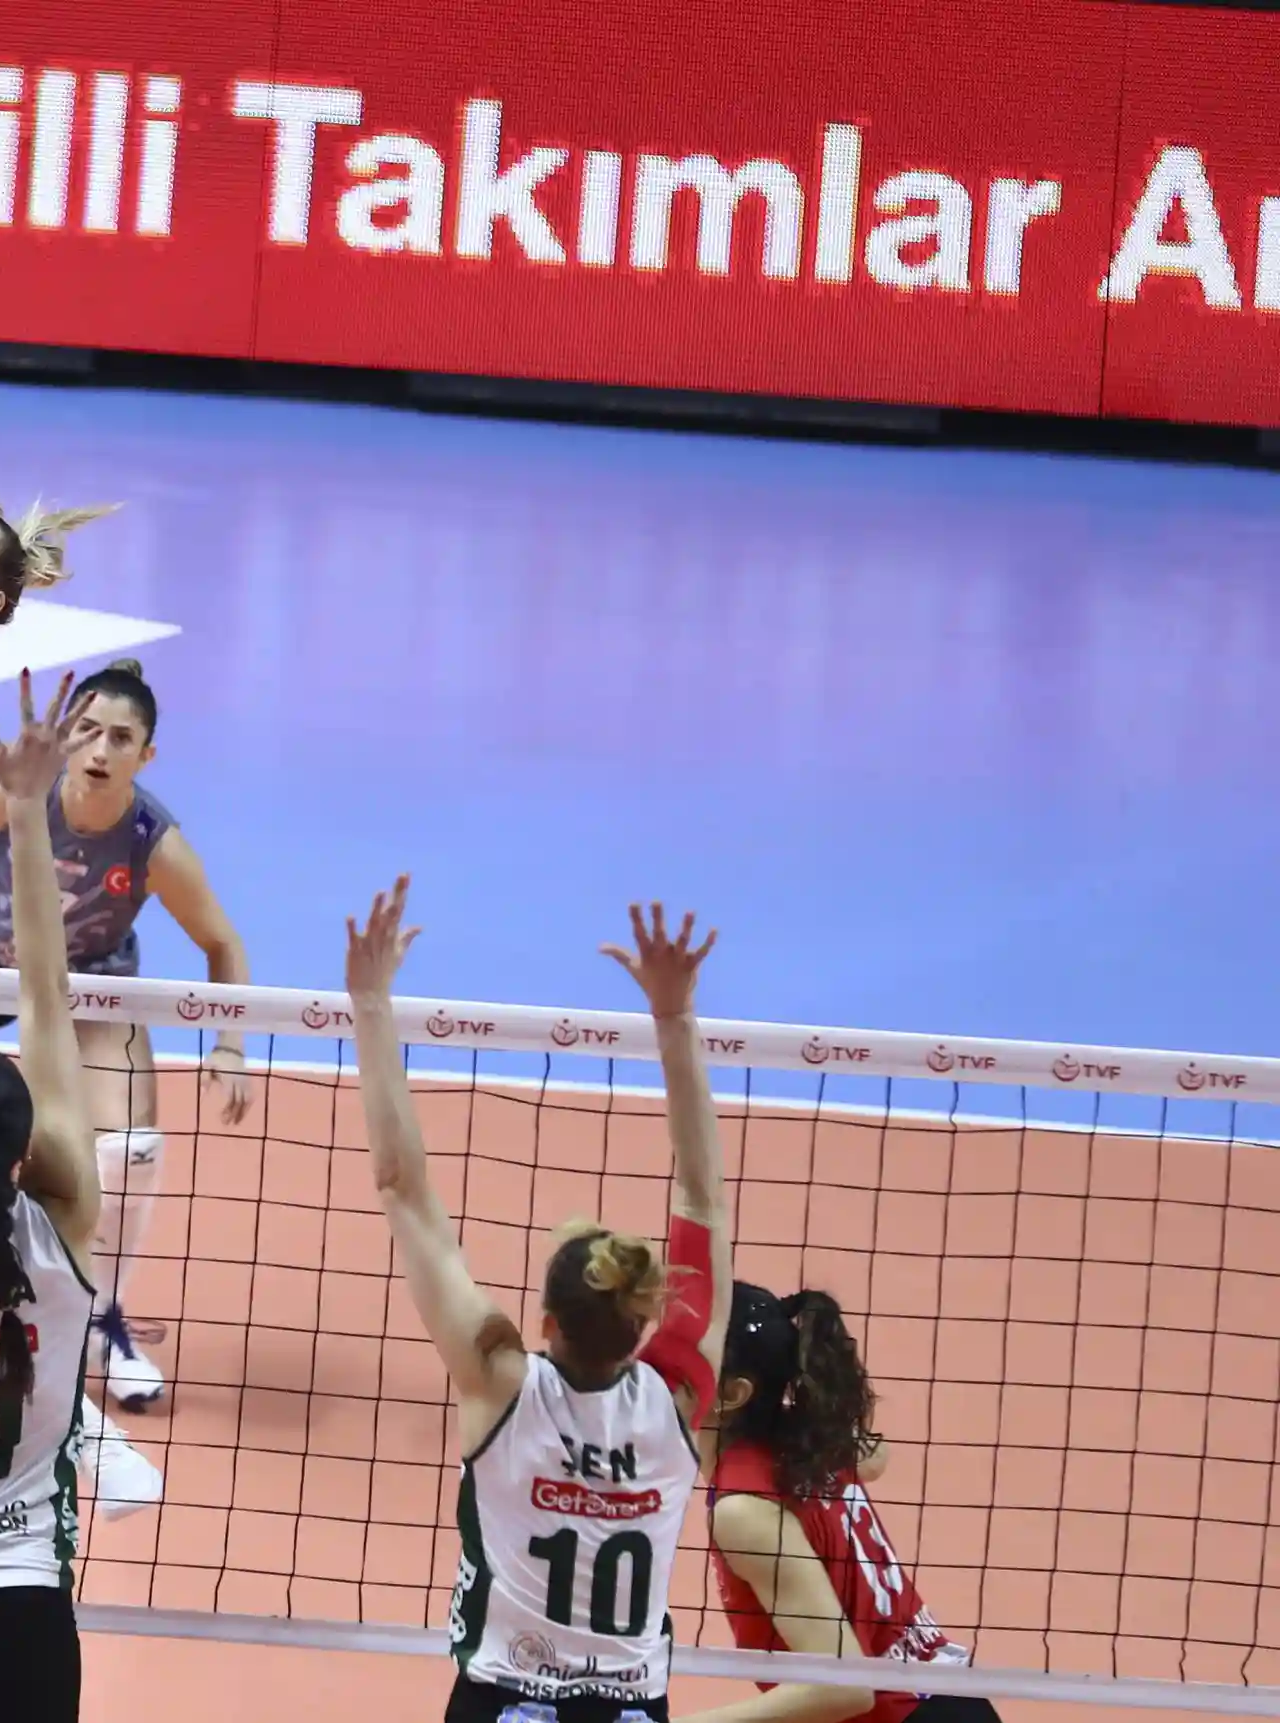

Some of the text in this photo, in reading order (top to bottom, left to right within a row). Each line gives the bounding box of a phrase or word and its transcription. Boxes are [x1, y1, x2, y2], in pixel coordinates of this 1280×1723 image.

[233, 80, 1062, 297] Takımlar
[82, 993, 120, 1010] TVF
[207, 1003, 247, 1019] TVF
[457, 1020, 496, 1036] TVF
[582, 1028, 621, 1045] TVF
[707, 1038, 746, 1054] TVF
[833, 1046, 873, 1062] TVF
[959, 1054, 997, 1070] TVF
[1084, 1063, 1122, 1079] TVF
[1209, 1071, 1248, 1088] TVF
[528, 1529, 653, 1638] 10
